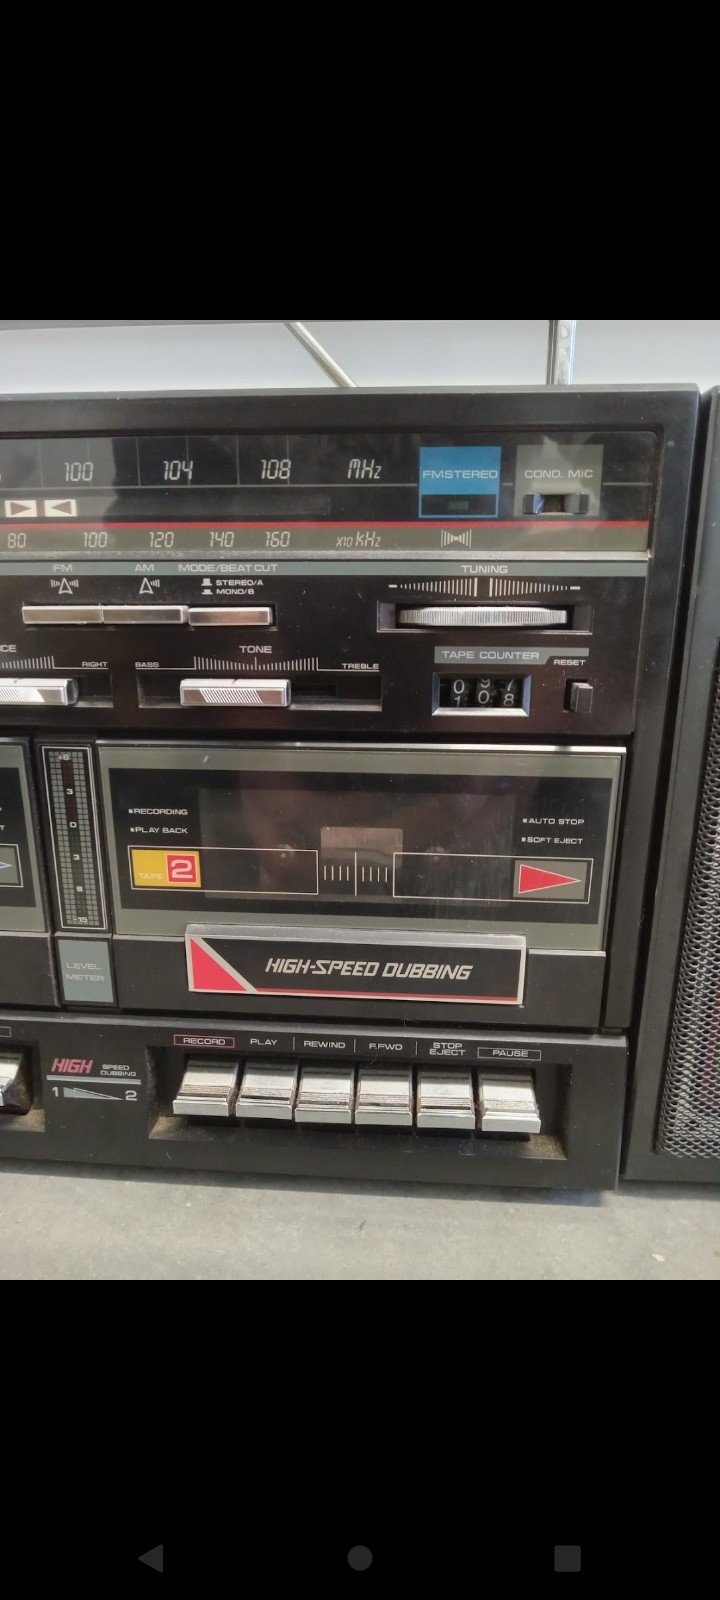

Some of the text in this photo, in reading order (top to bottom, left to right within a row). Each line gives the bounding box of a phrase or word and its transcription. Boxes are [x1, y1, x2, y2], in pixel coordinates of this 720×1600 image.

[64, 461, 94, 482] 100
[163, 460, 194, 481] 104
[260, 459, 291, 480] 108
[347, 458, 382, 479] MHz
[524, 469, 594, 479] COND. MIC
[7, 533, 27, 549] 80
[83, 532, 108, 548] 100
[149, 532, 174, 548] 120
[209, 532, 234, 548] 140
[265, 532, 290, 548] 160
[53, 564, 73, 573] FM
[134, 564, 155, 573] AM
[178, 563, 278, 573] MODE/BEAT CUT
[461, 565, 508, 574] TUNING
[215, 579, 264, 587] STEREO/A
[0, 644, 17, 653] CE
[239, 645, 272, 654] TONE
[442, 650, 539, 660] TAPE COUNTER
[135, 661, 160, 669] BASS
[341, 662, 380, 670] TREBLE
[134, 808, 189, 816] RECORDING
[135, 826, 159, 834] PLAY
[139, 859, 194, 880] TAPE 2
[66, 962, 102, 971] LEVEL
[265, 958, 473, 980] HIGH-SPEED DUBBING
[65, 973, 104, 983] METER
[183, 1037, 226, 1045] RECORD
[250, 1037, 278, 1046] PLAY
[303, 1039, 346, 1049] REWIND
[432, 1042, 463, 1051] STOP
[429, 1048, 466, 1057] EJECT
[492, 1049, 529, 1058] PAUSE
[51, 1057, 93, 1074] HIGH
[102, 1063, 130, 1071] SPEED
[125, 1089, 137, 1101] 2
